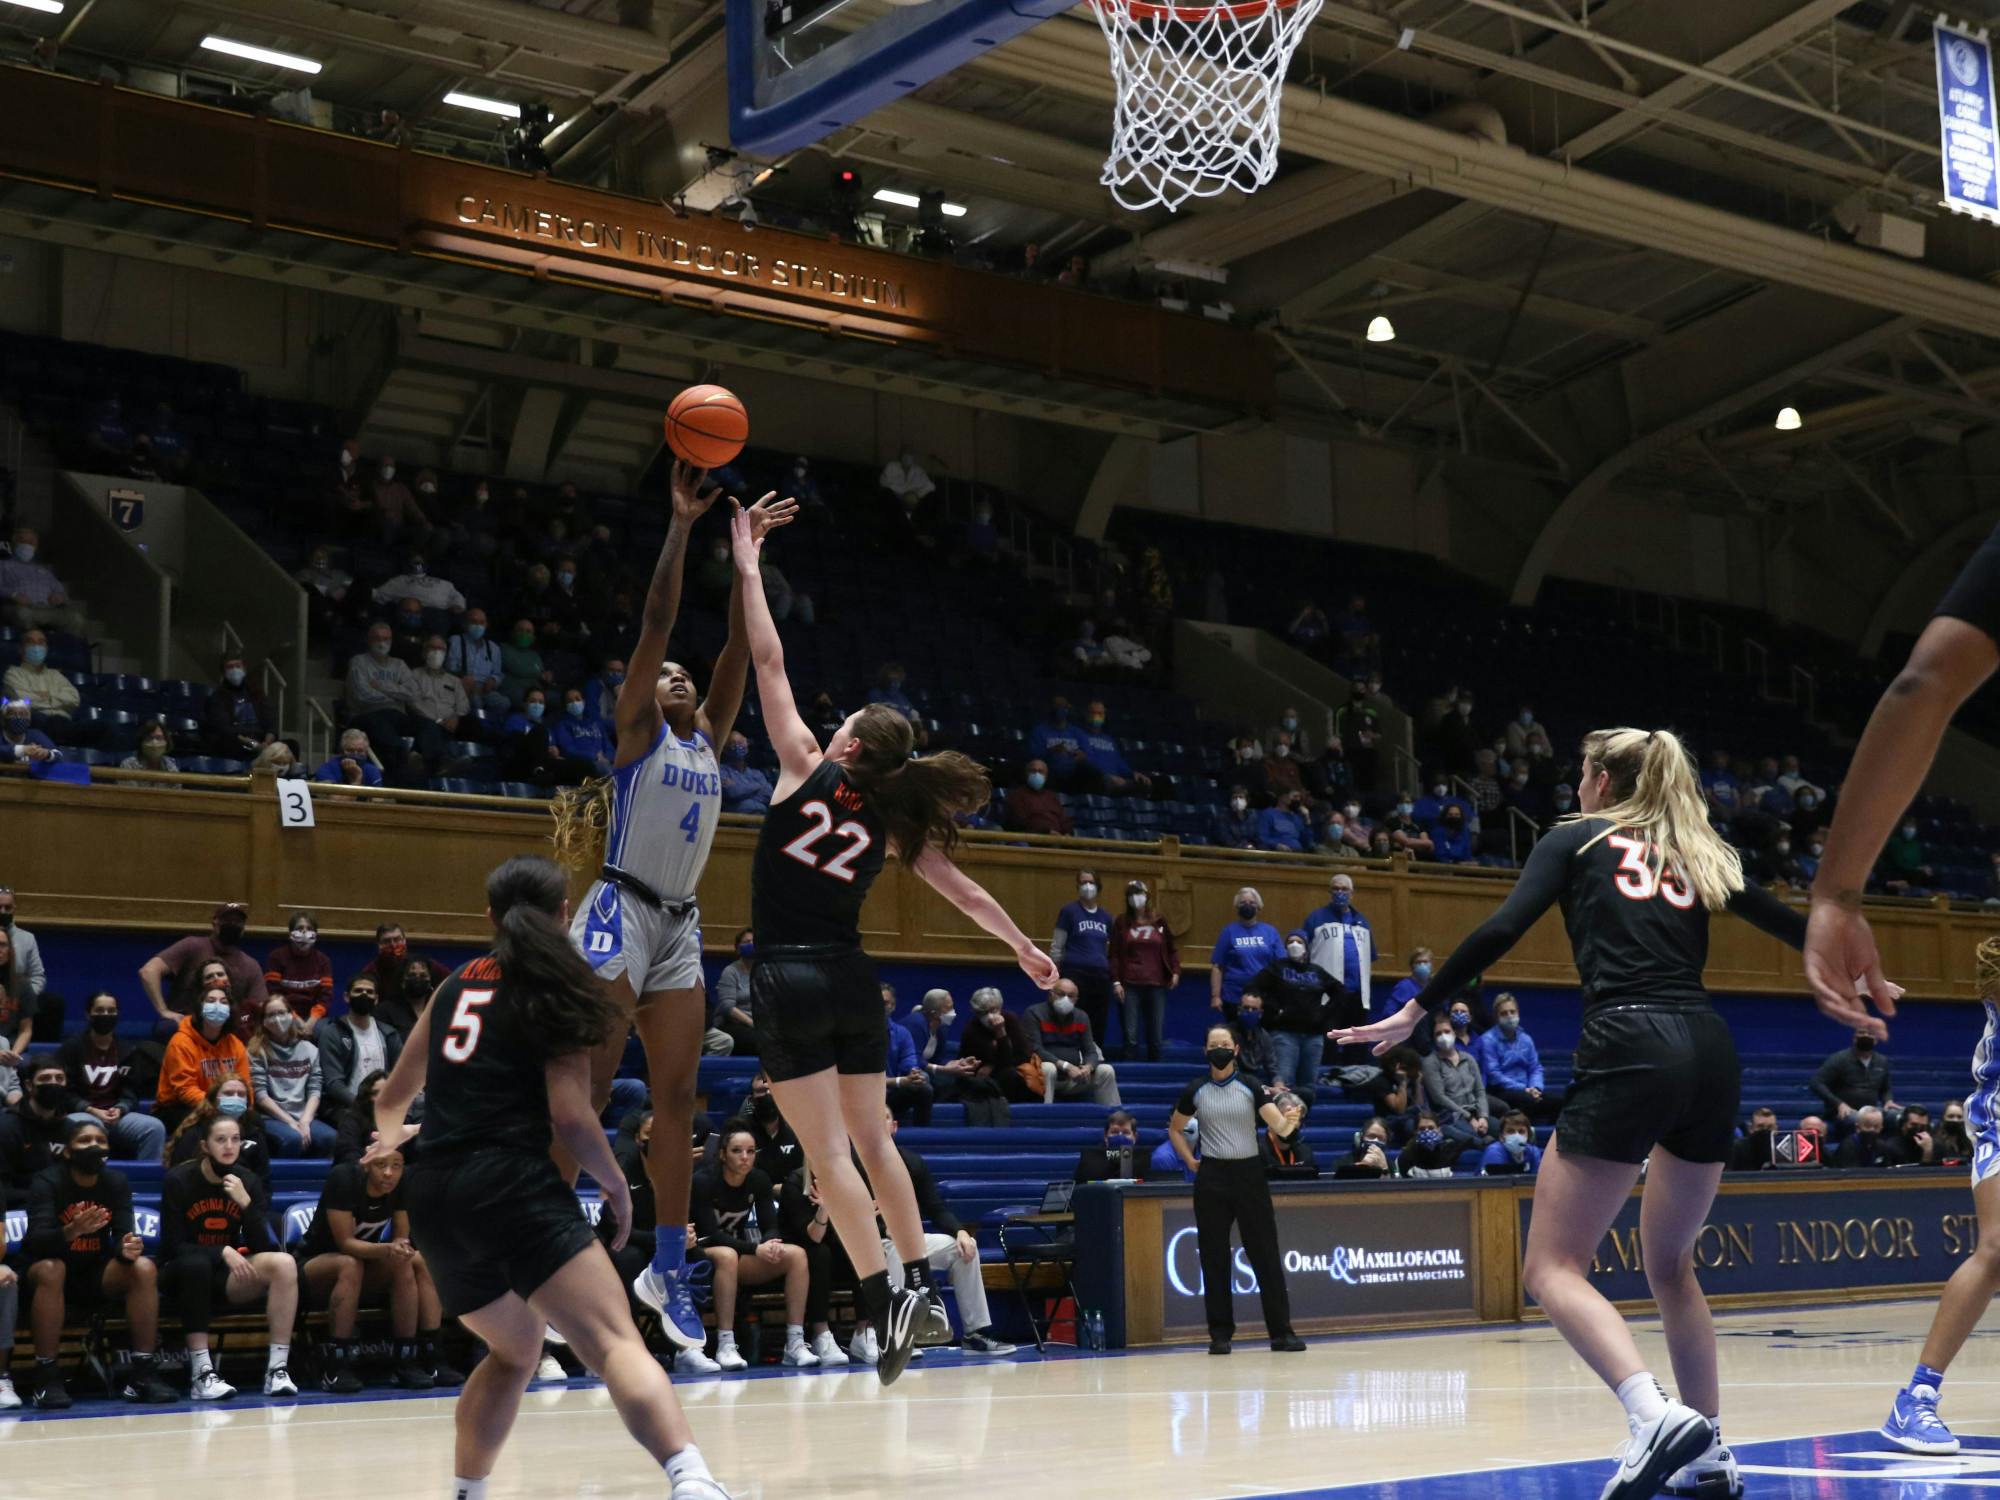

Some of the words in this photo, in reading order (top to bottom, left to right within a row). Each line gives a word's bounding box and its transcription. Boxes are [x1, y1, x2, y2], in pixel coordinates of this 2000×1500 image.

[455, 194, 622, 251] CAMERON
[637, 229, 760, 279] INDOOR
[772, 258, 908, 309] STADIUM
[119, 501, 136, 524] 7
[661, 763, 720, 797] DUKE
[287, 792, 308, 823] 3
[679, 801, 701, 844] 4
[779, 798, 873, 884] 22
[589, 930, 614, 953] D
[1235, 936, 1265, 947] DUKE
[441, 987, 497, 1063] 5
[84, 1064, 118, 1086] VT
[49, 1141, 67, 1155] VT
[780, 1144, 796, 1155] VT
[1977, 1142, 1994, 1164] D
[184, 1196, 225, 1221] VIRGINIA
[225, 1198, 242, 1220] TEC
[133, 1212, 160, 1237] KE
[1776, 1217, 1920, 1264] INDOOR
[1360, 1272, 1405, 1284] SURGERY
[1407, 1269, 1466, 1282] ASSOCIATES
